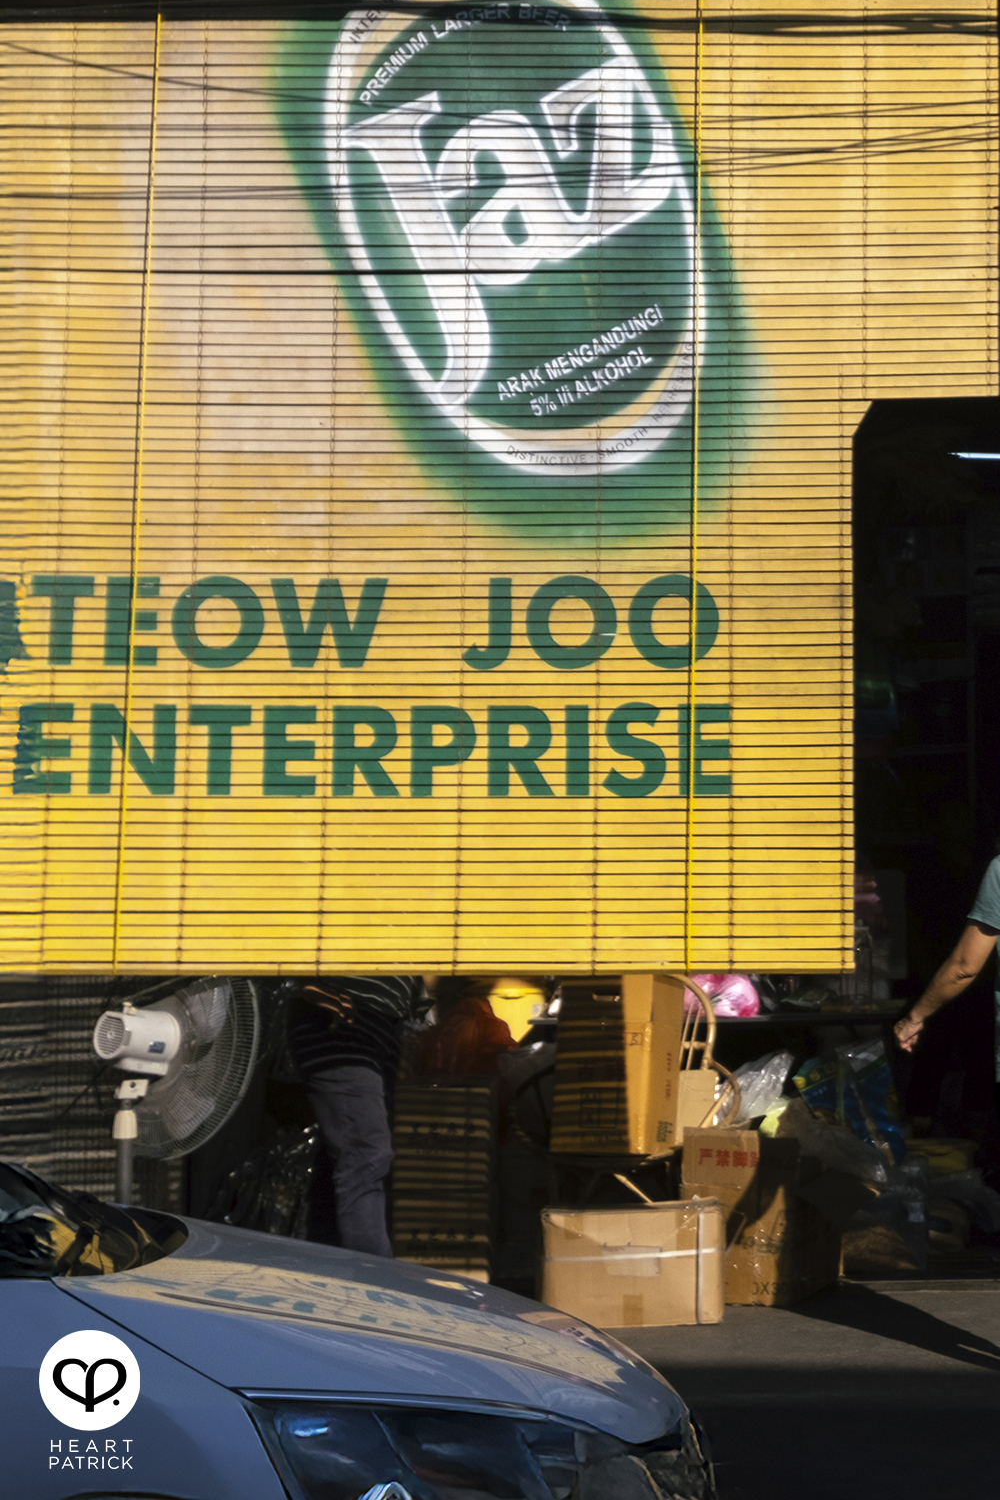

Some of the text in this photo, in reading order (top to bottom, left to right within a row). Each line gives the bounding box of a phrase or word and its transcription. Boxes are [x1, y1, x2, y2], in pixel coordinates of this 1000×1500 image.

[358, 2, 572, 106] PREMIUM LARGER BEER
[495, 366, 546, 401] ARAK
[528, 393, 558, 416] 5%
[574, 346, 654, 399] ALKOHOL
[598, 426, 649, 459] SMOOTH
[32, 573, 720, 670] TEOW JOO
[13, 701, 732, 798] ENTERPRISE
